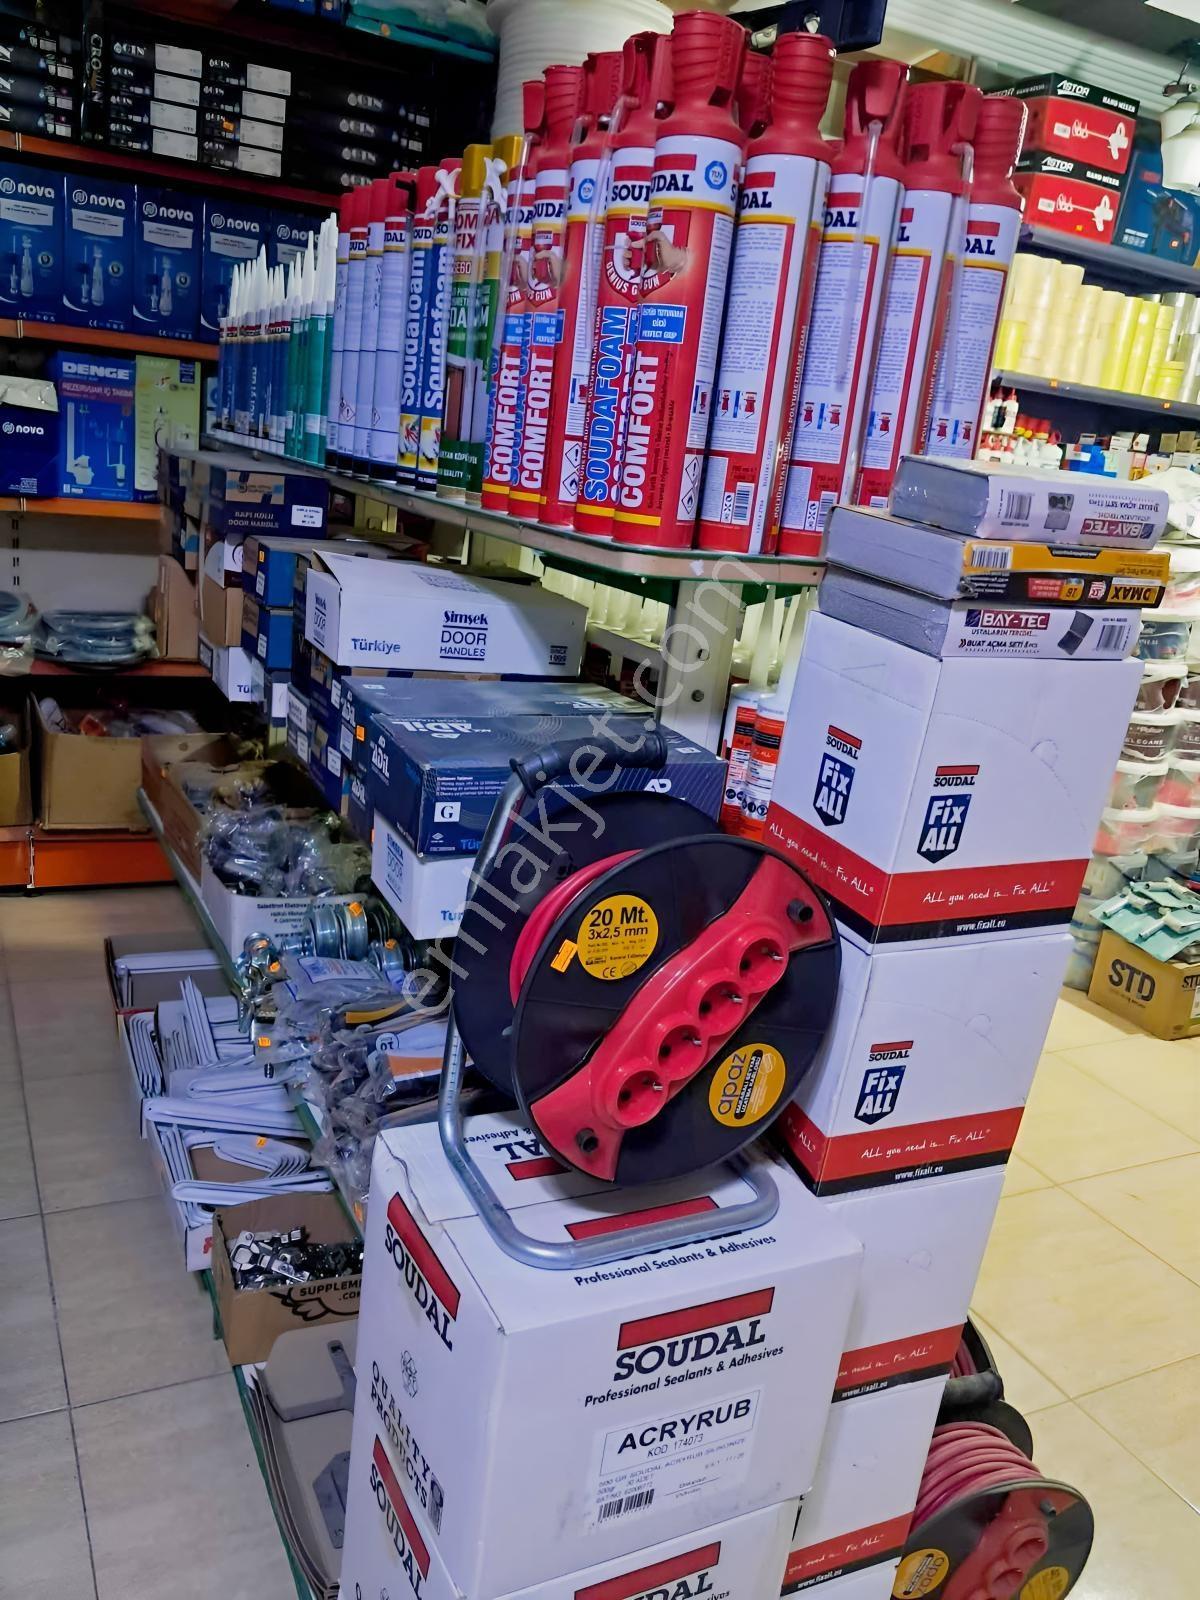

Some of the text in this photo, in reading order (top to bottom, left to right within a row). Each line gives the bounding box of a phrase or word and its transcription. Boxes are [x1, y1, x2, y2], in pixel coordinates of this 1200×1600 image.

[17, 182, 55, 199] nova
[89, 195, 126, 211] nova
[159, 207, 194, 222] nova
[227, 220, 260, 233] nova
[401, 250, 425, 407] Soudafoam
[62, 361, 130, 380] DENGE
[585, 306, 628, 502] SOUDAFOAM
[491, 352, 519, 482] COMFORT
[520, 353, 553, 489] COMFORT
[15, 424, 45, 436] nova
[621, 351, 659, 508] COMFORT
[1082, 519, 1141, 537] BAY-TEC
[983, 612, 1049, 629] BAY-TEC
[351, 638, 401, 655] Türkiye
[441, 630, 487, 645] DOOR
[440, 646, 486, 657] HANDLES
[825, 735, 859, 760] SOUDAL
[822, 759, 850, 795] Fix
[933, 775, 976, 787] SOUDAL
[440, 805, 454, 819] G
[815, 788, 845, 822] ALL
[928, 798, 966, 825] Fix
[922, 826, 958, 853] ALL
[769, 822, 785, 839] ALL
[836, 865, 848, 884] Fix
[923, 892, 945, 904] ALL
[948, 893, 965, 904] you
[968, 889, 990, 900] need
[1013, 884, 1026, 896] Fix
[589, 906, 649, 928] 20 Mt.
[957, 918, 1007, 932] www.fixall.eu
[588, 925, 649, 941] 3x2,5 mm
[1108, 958, 1156, 1002] STD
[868, 1050, 910, 1062] SOUDAL
[865, 1070, 900, 1094] Fix
[858, 1092, 894, 1117] ALL
[861, 1146, 882, 1158] ALL
[949, 1134, 962, 1145] Fix
[895, 1165, 943, 1181] www.fixall.eu
[574, 1234, 777, 1286] Professional Sealants & Adhesives
[300, 1278, 361, 1296] SUPPLEM
[384, 1223, 453, 1352] SOUDAL
[613, 1319, 766, 1382] SOUDAL
[584, 1346, 784, 1408] Professional Sealants & Adhesives
[371, 1360, 431, 1479] QUALITY
[617, 1398, 752, 1454] ACRYRUB
[370, 1381, 428, 1509] PRODUCTS
[647, 1443, 668, 1458] KOD
[370, 1462, 423, 1600] SOUDAL
